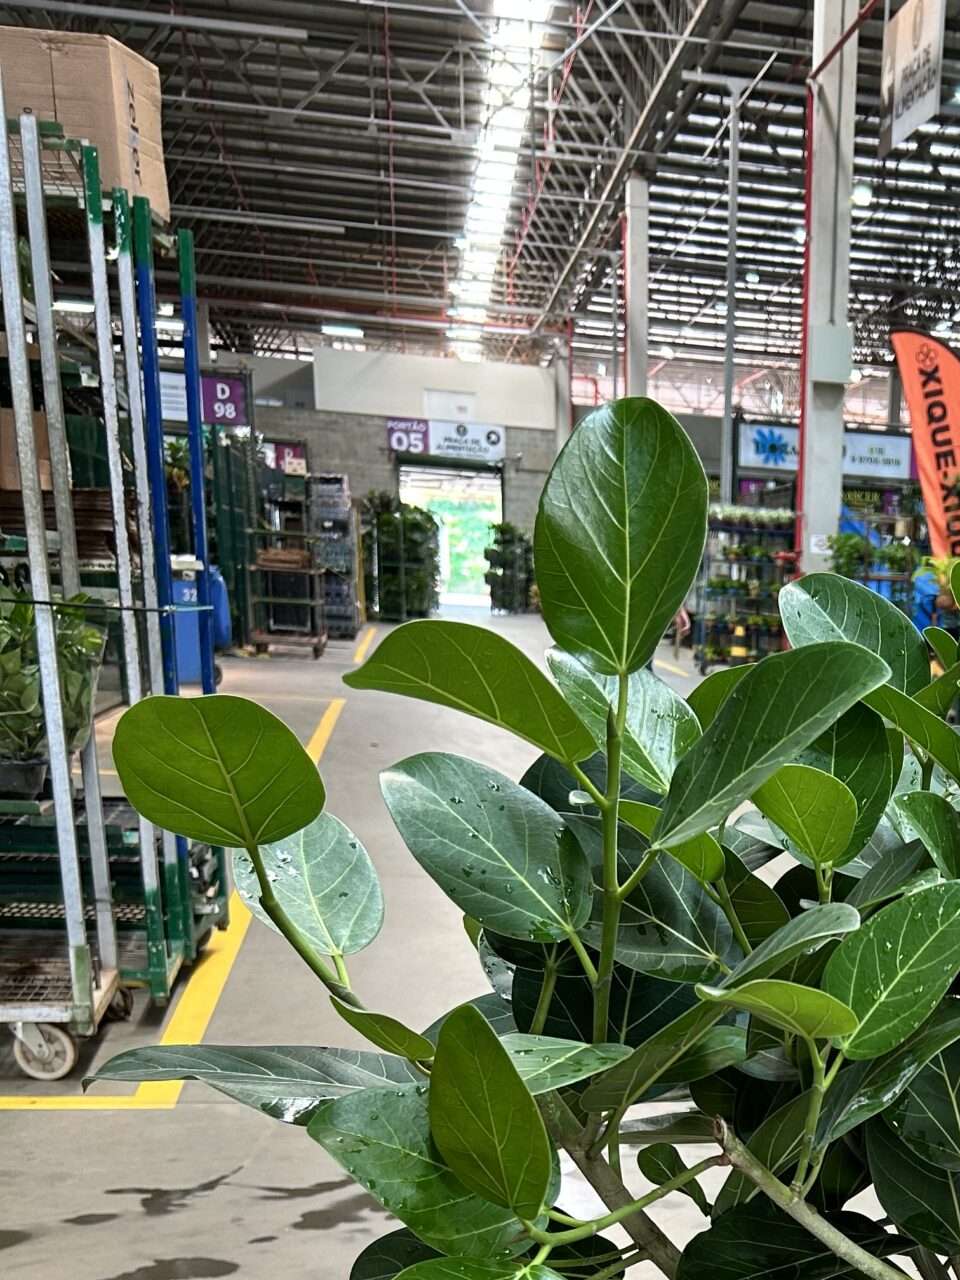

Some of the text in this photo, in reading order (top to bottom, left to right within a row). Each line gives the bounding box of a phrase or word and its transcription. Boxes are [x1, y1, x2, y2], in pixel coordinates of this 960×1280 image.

[216, 383, 230, 400] D
[213, 402, 236, 419] 98
[390, 431, 425, 454] 05
